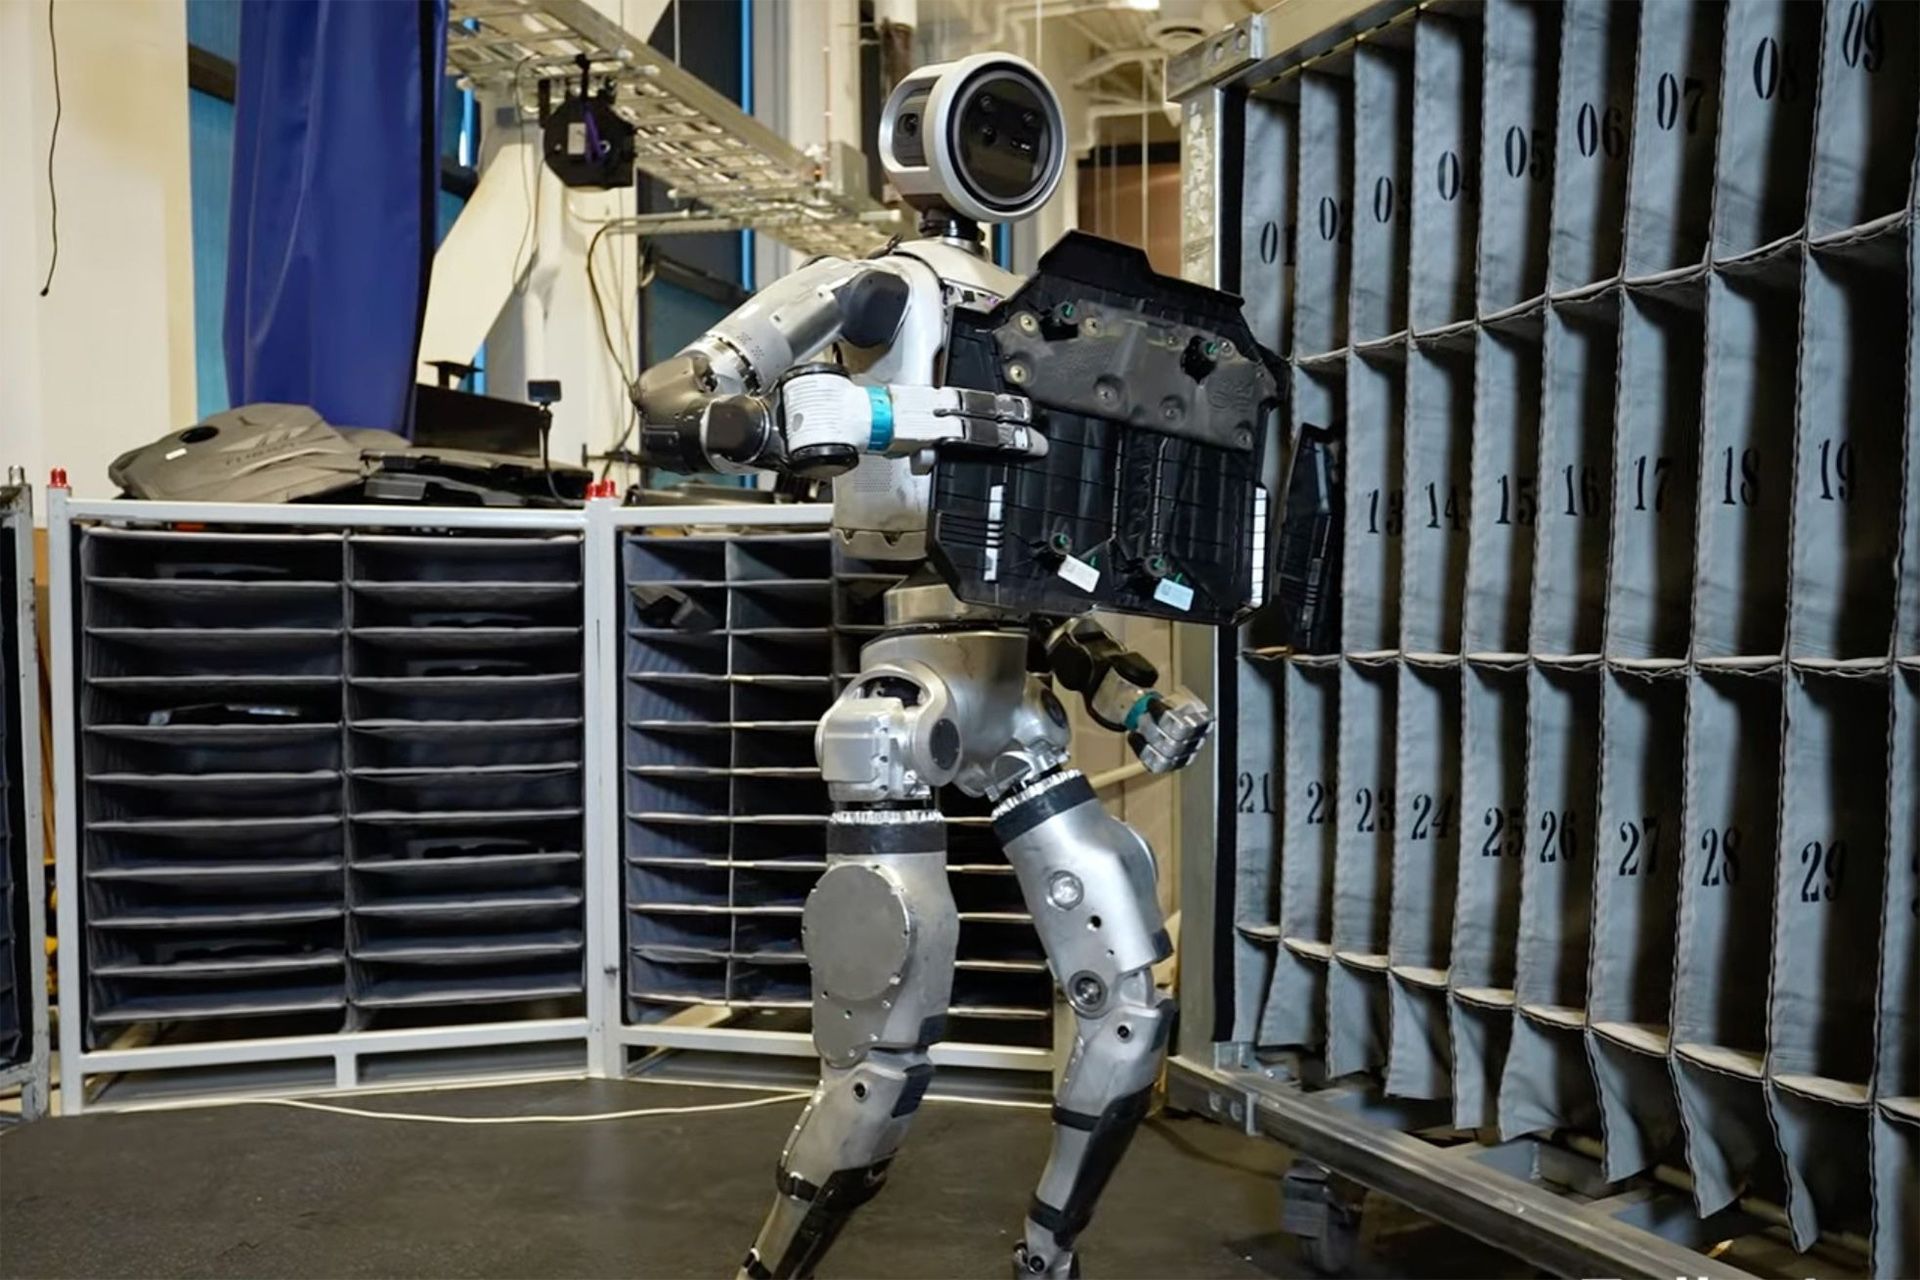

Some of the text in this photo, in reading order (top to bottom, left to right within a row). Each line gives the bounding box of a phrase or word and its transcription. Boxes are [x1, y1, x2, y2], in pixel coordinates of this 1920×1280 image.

[1843, 1, 1884, 73] 09
[1577, 102, 1624, 159] 06
[1657, 72, 1704, 134] 07
[1505, 125, 1546, 182] 05
[1562, 464, 1600, 517] 16
[1633, 456, 1672, 512] 17
[1722, 446, 1759, 507] 18
[1819, 438, 1855, 501] 19
[1425, 482, 1462, 530] 14
[1496, 475, 1536, 525] 15
[1238, 772, 1275, 814] 21
[1356, 788, 1394, 832] 23
[1412, 794, 1454, 840] 24
[1482, 807, 1524, 857] 25
[1540, 811, 1577, 864] 26
[1619, 816, 1662, 876] 27
[1702, 827, 1742, 887] 28
[1801, 840, 1847, 902] 29
